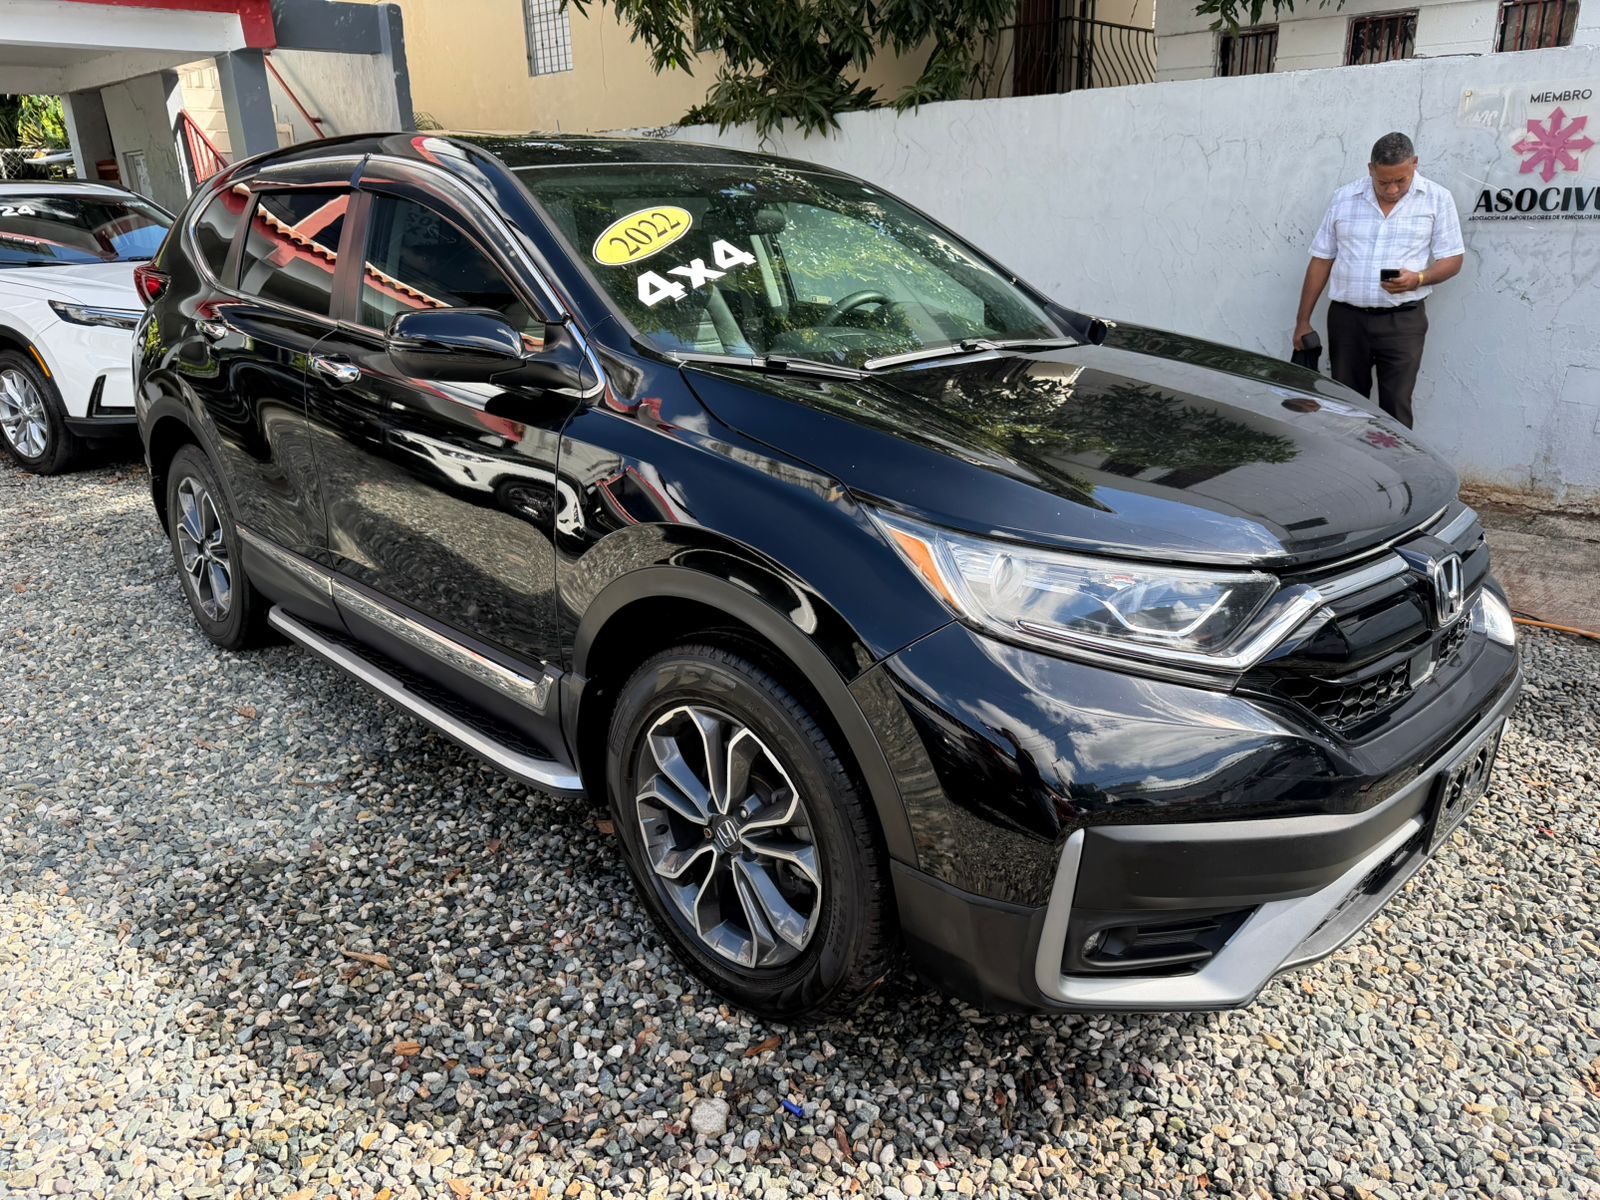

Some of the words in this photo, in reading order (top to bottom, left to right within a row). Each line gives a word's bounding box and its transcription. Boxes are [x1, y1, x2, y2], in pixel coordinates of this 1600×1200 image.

[1530, 89, 1592, 103] MIEMBRO
[1508, 213, 1552, 221] IMPORTADORES
[609, 212, 681, 256] 2022
